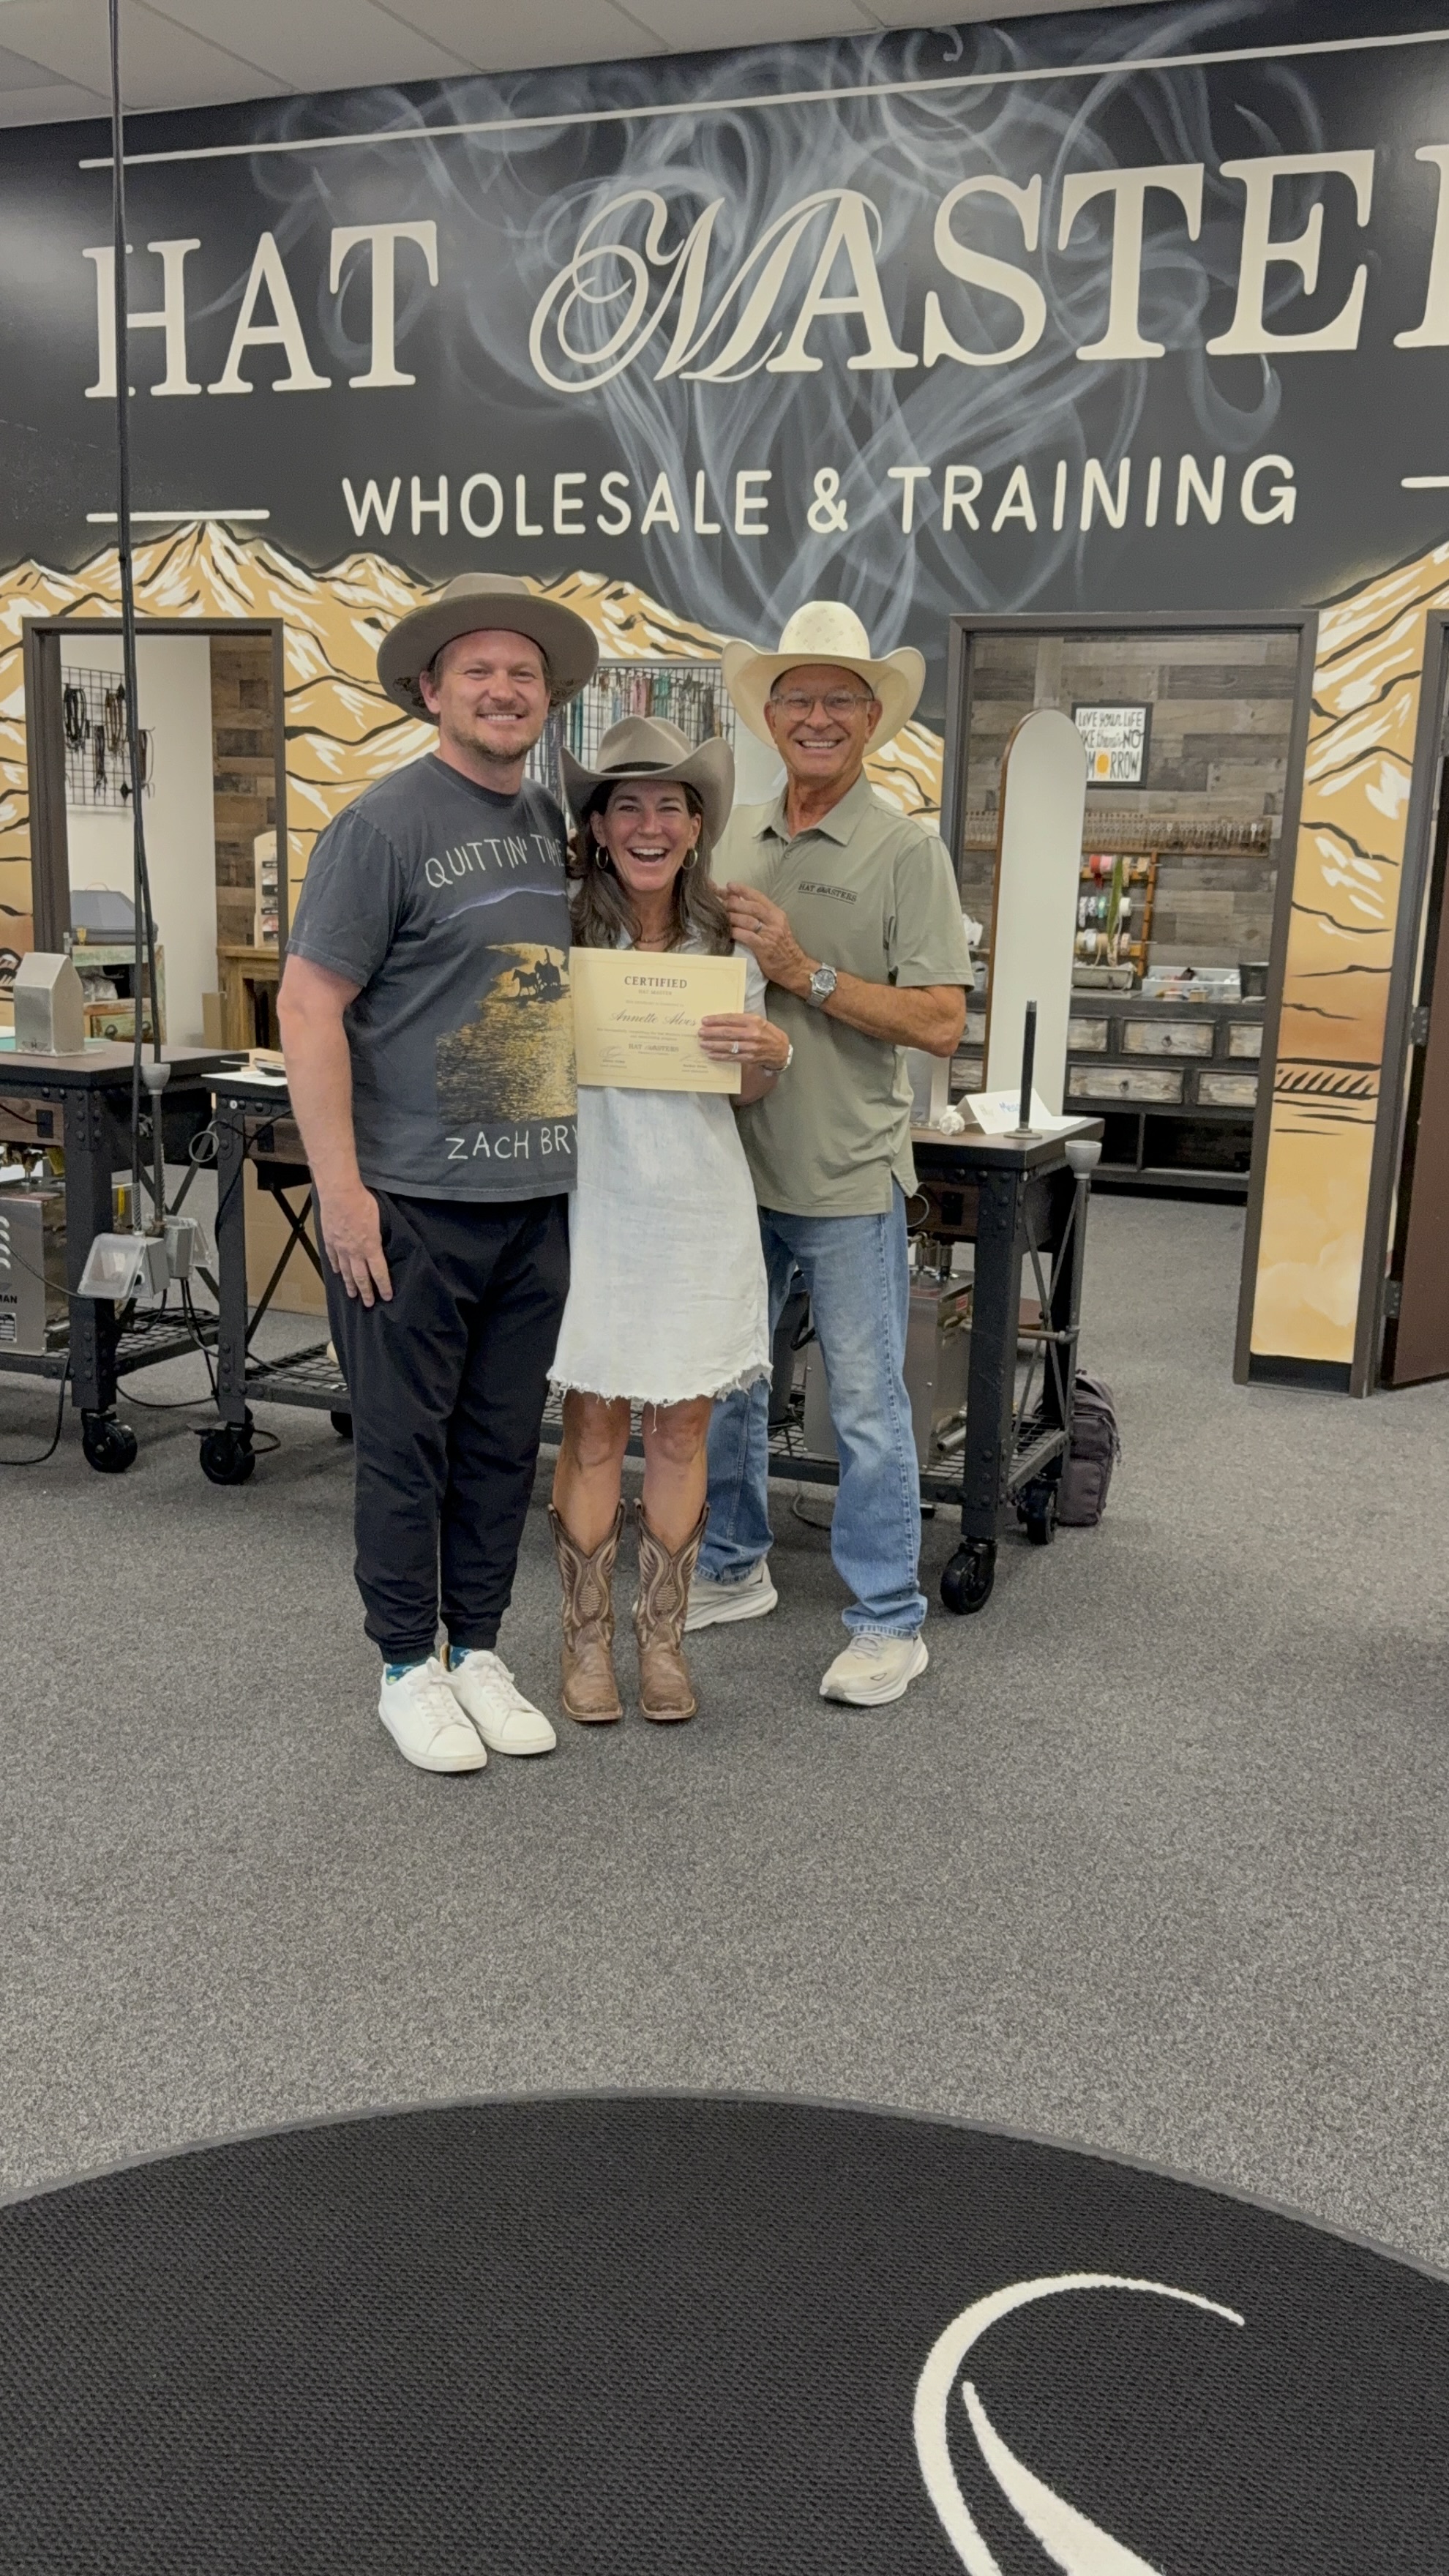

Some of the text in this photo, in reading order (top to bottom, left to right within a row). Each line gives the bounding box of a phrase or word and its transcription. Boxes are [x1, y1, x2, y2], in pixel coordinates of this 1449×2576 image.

[83, 220, 438, 397] HAT
[342, 454, 1298, 538] WHOLESALE & TRAINING
[425, 833, 565, 888] QUITTIN' TIME
[798, 883, 858, 902] HAT MASTERS
[624, 975, 688, 989] CERTIFIED
[610, 1009, 658, 1025] Annette
[446, 1131, 529, 1160] ZACH
